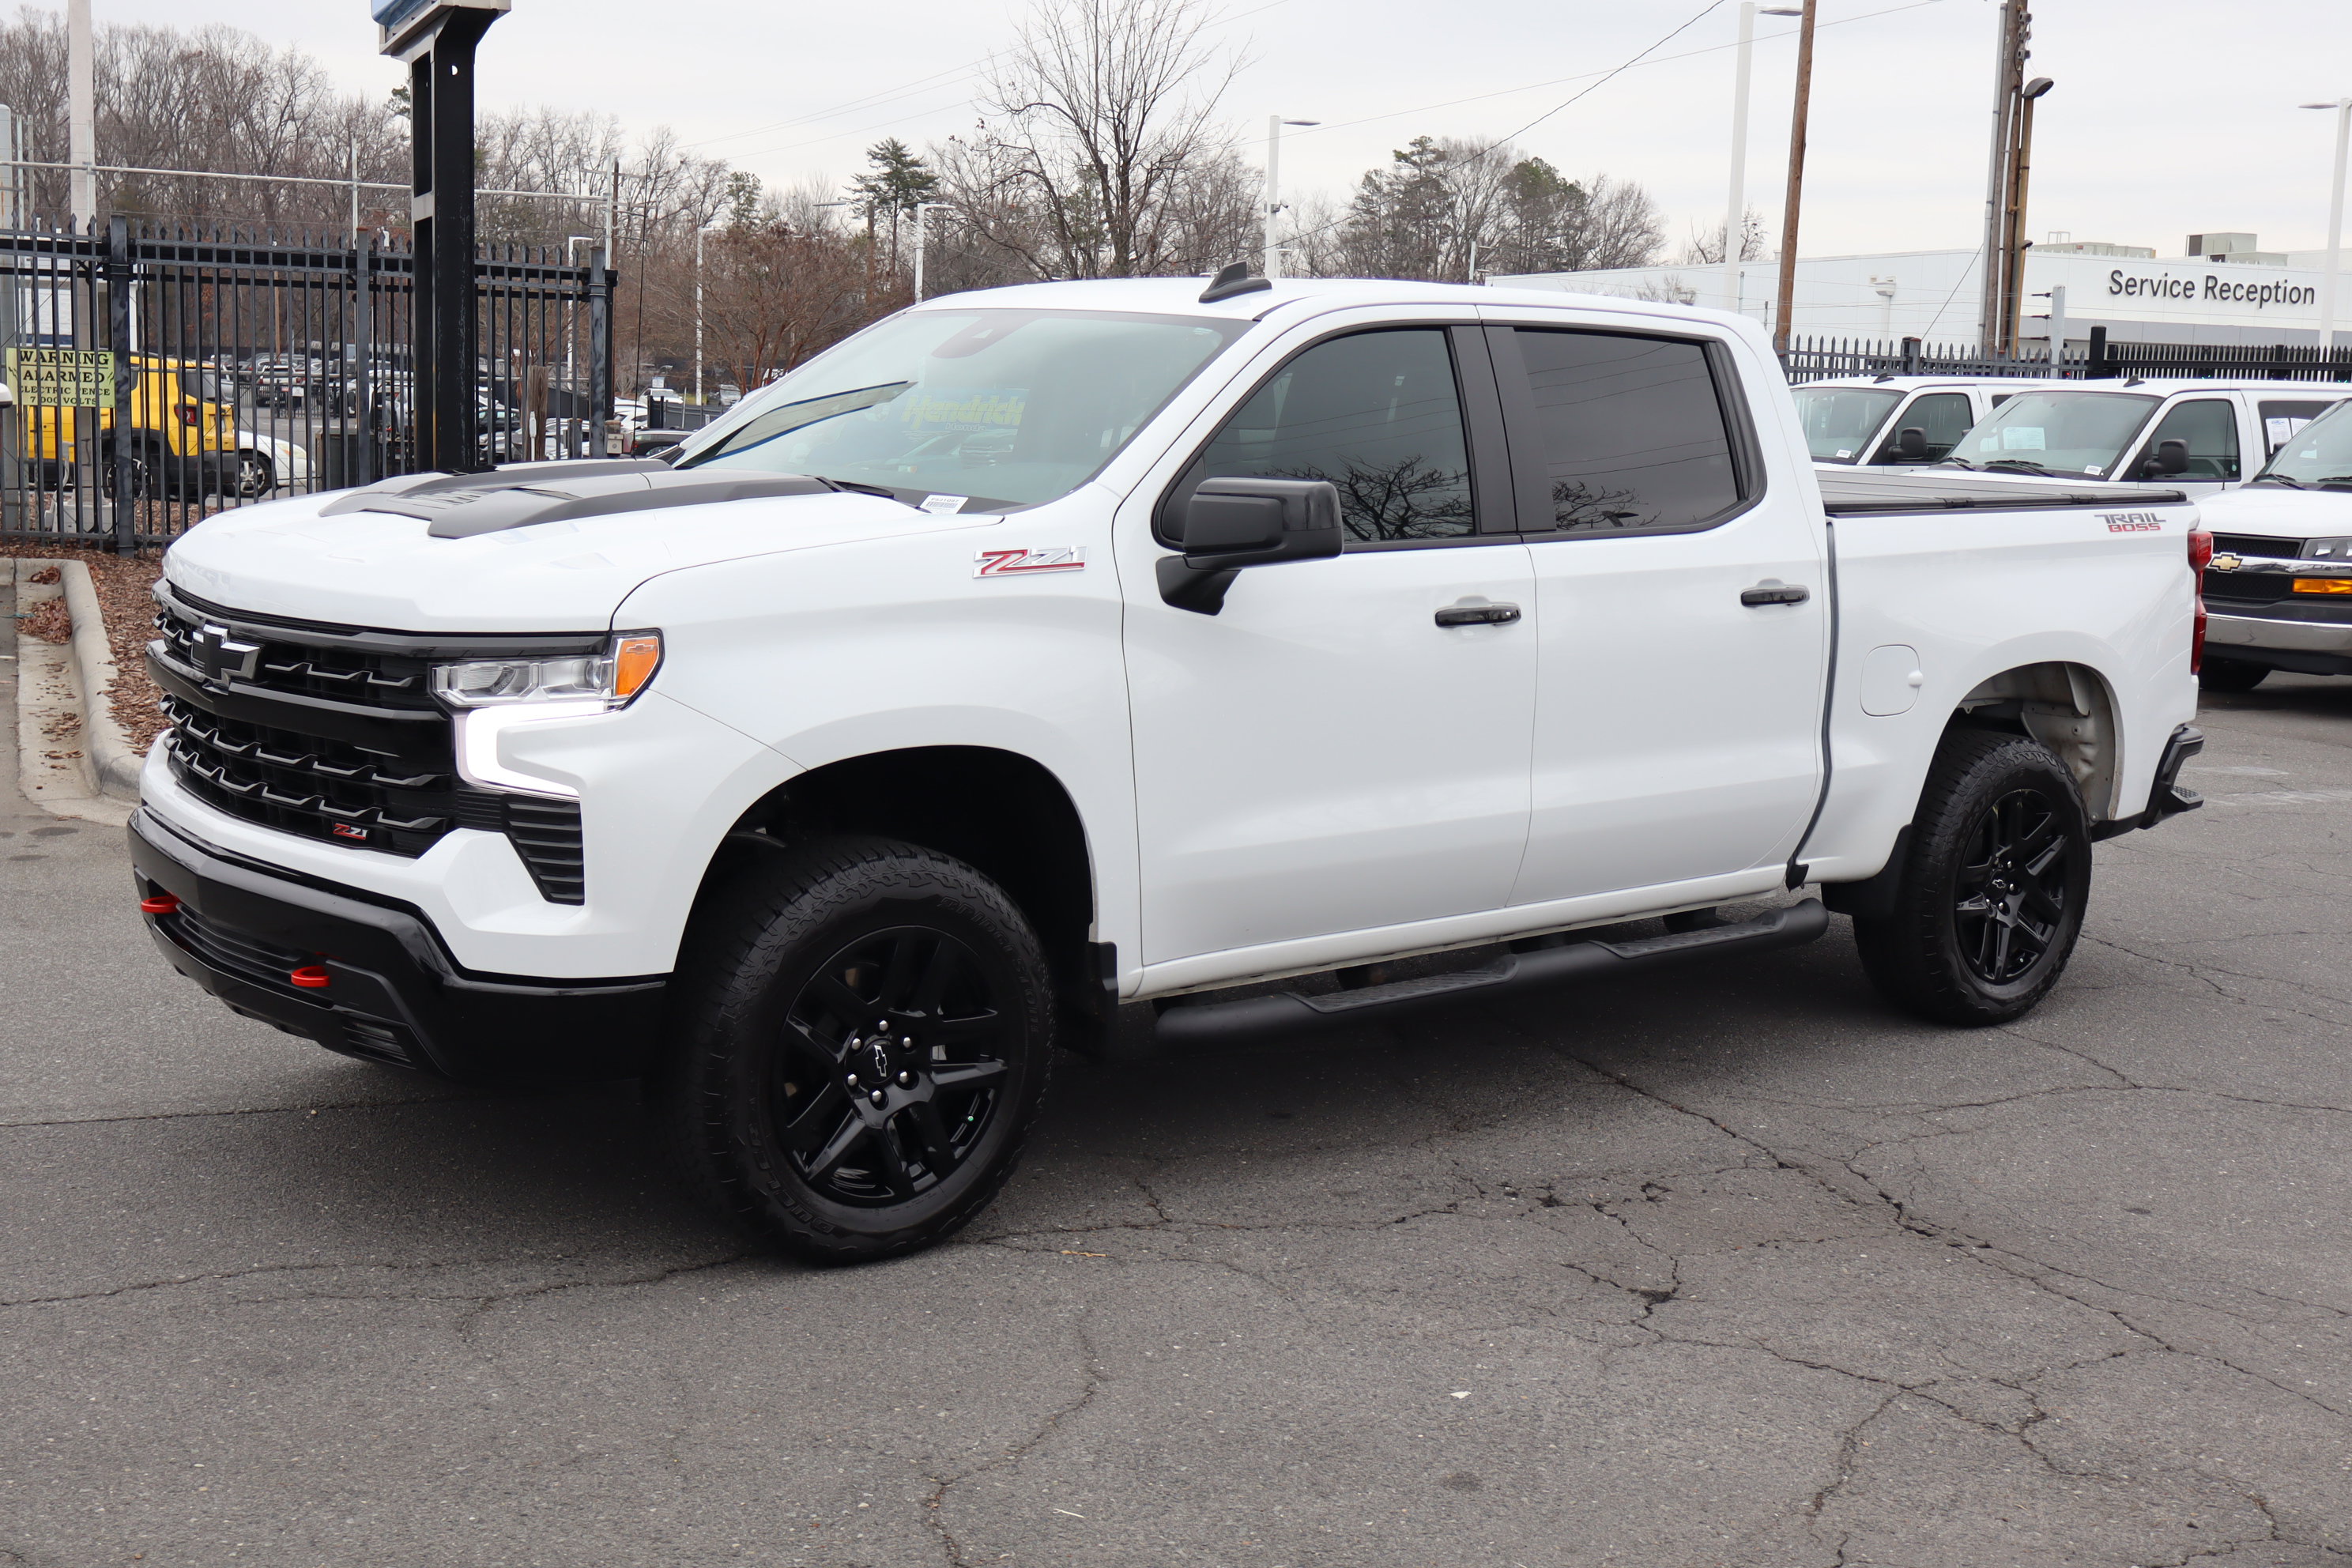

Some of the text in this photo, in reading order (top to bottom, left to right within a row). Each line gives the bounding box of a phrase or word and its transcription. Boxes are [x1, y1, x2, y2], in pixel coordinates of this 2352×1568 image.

[2109, 269, 2316, 309] Service Reception
[23, 369, 105, 383] ALARMED
[75, 386, 111, 396] ENCE
[901, 394, 1026, 430] Hendrick
[2094, 512, 2167, 524] TRAIL
[2108, 522, 2162, 533] BOSS
[973, 545, 1087, 579] Z71
[333, 823, 368, 840] Z71
